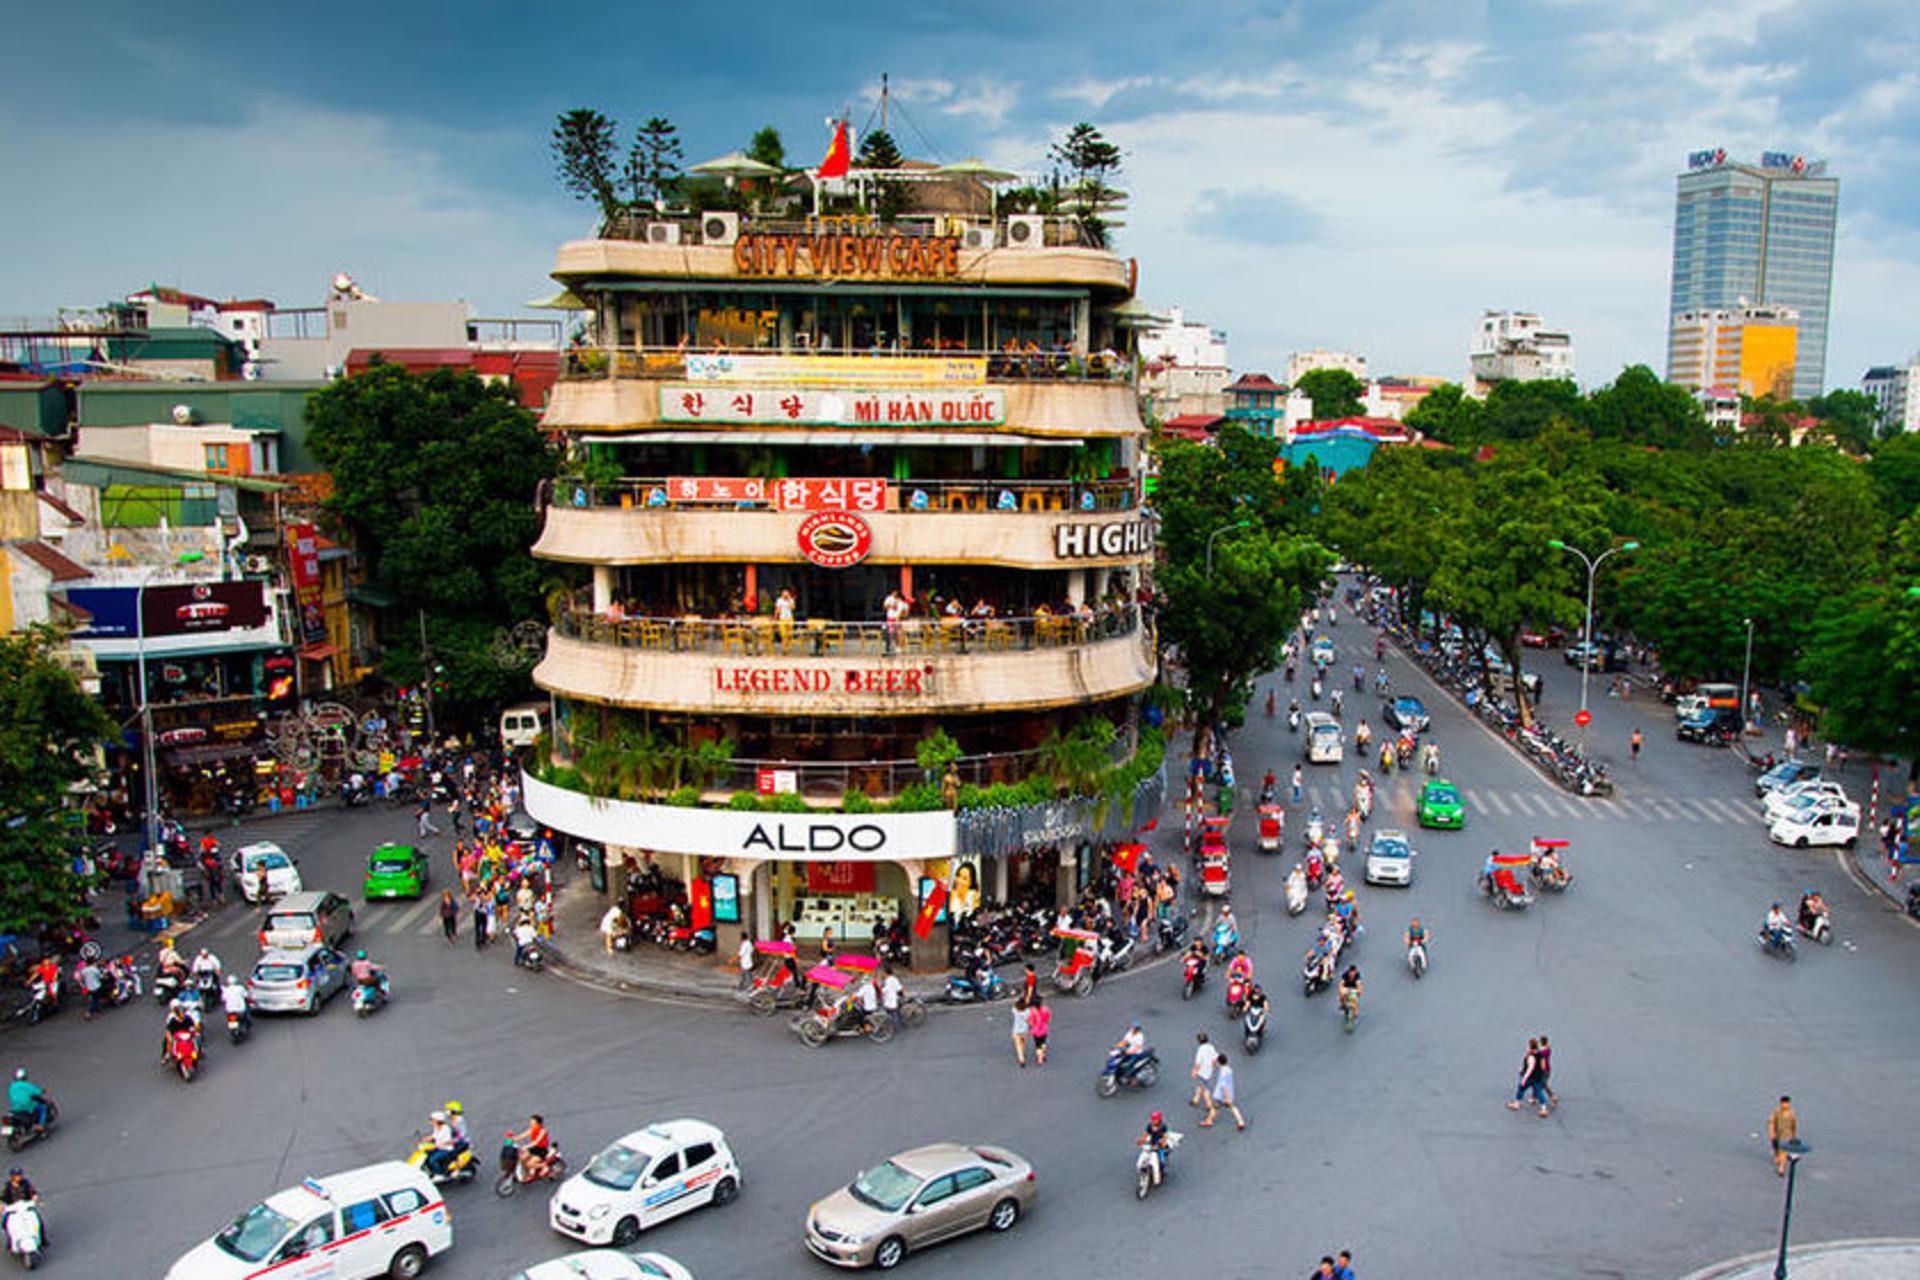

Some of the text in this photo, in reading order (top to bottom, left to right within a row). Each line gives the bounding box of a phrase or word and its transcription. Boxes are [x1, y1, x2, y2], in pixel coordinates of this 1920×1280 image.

[734, 235, 960, 275] CITY VIEW CAFE
[781, 479, 882, 509] 한식당
[715, 667, 923, 693] LEGEND BEER
[742, 823, 886, 851] ALDO
